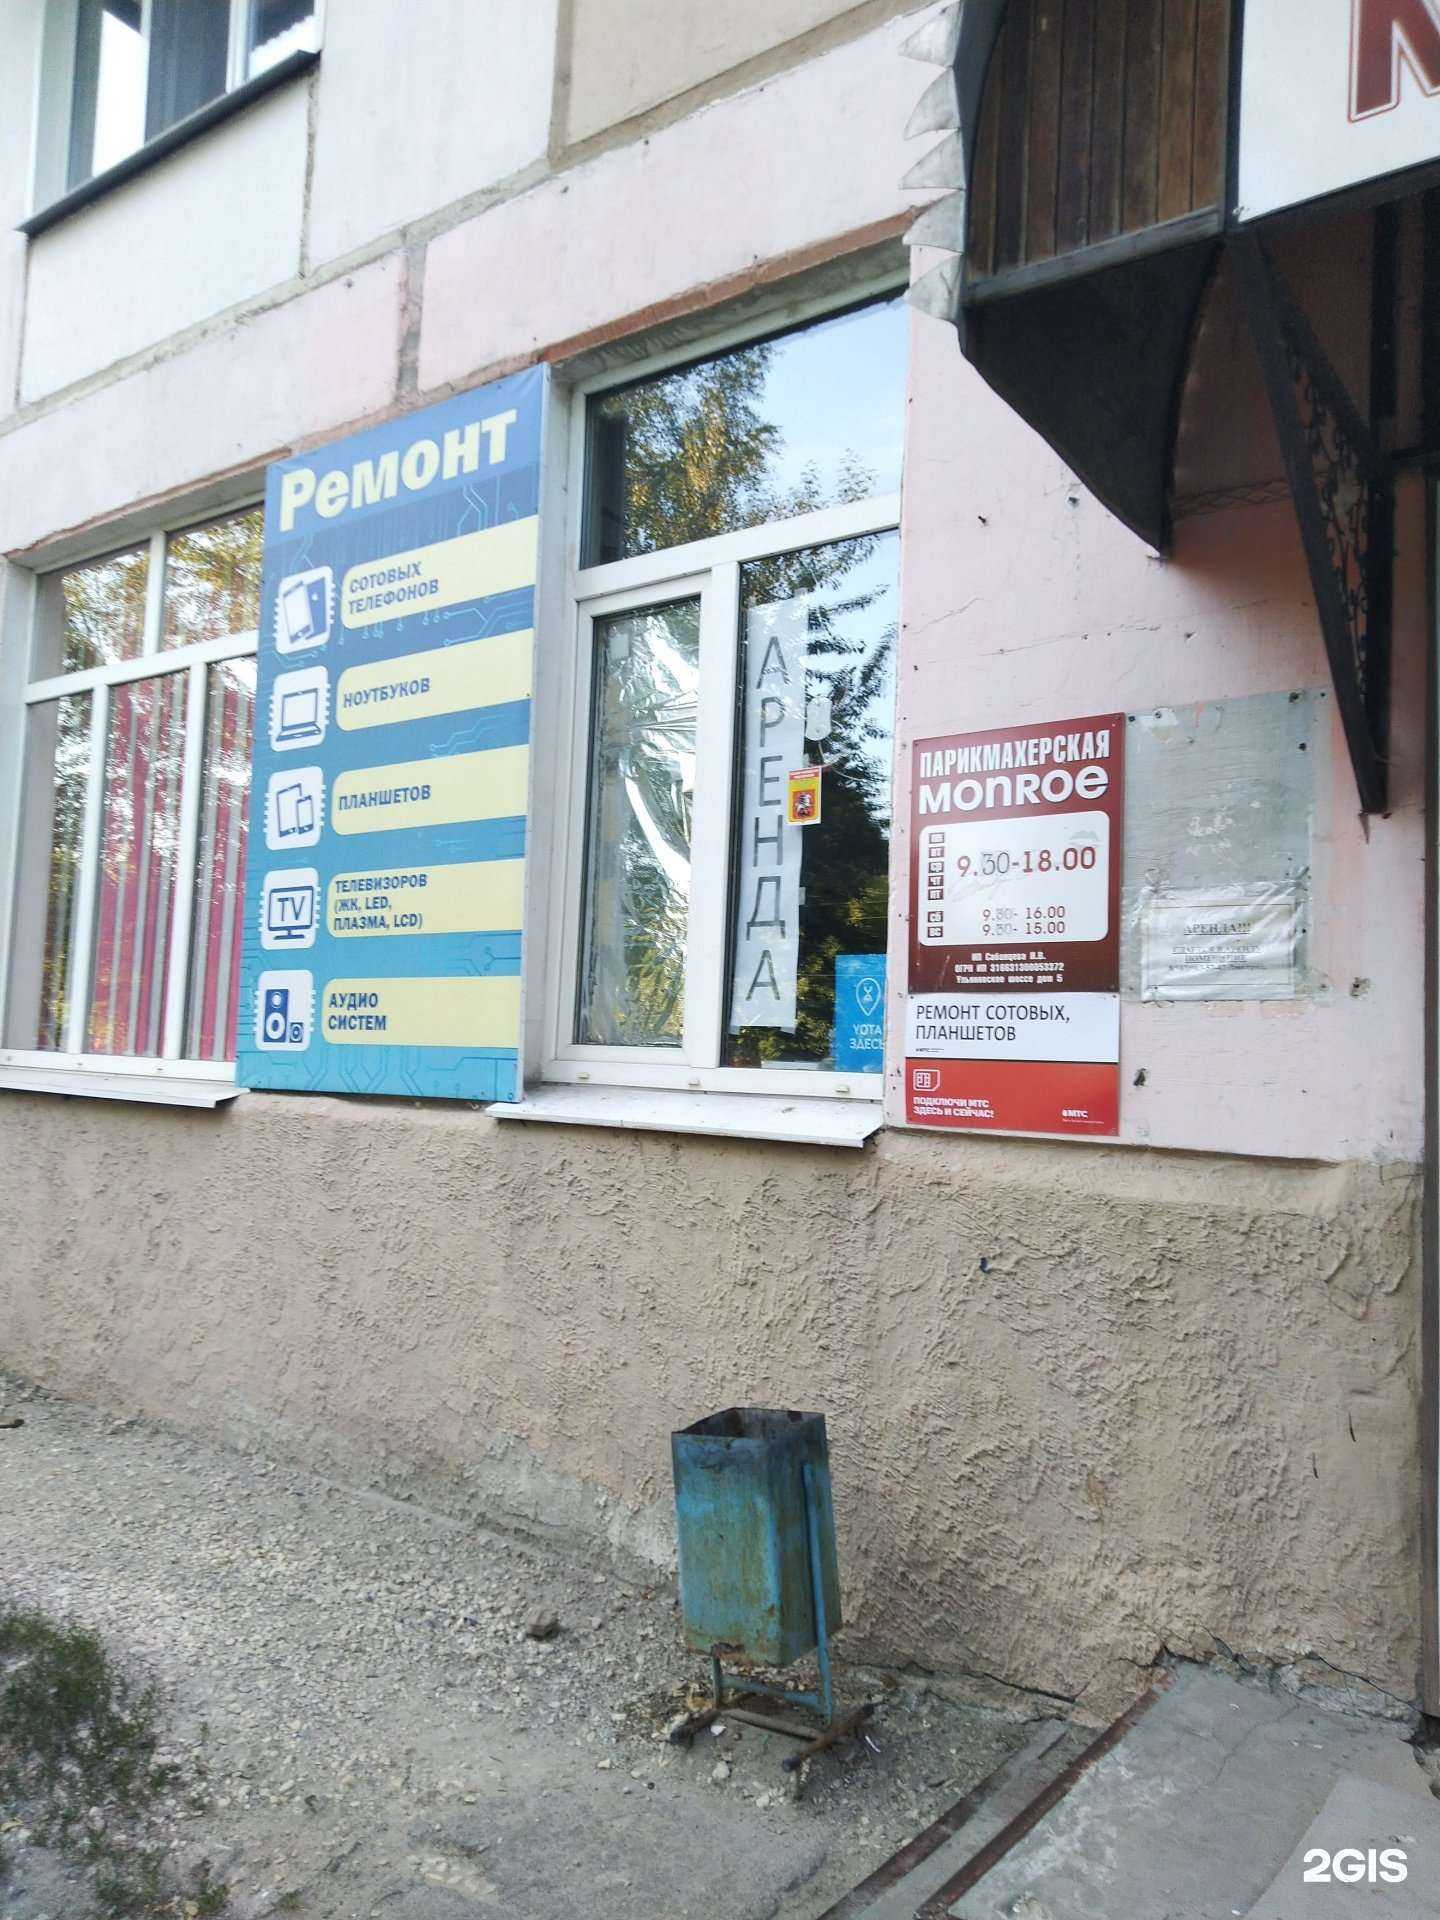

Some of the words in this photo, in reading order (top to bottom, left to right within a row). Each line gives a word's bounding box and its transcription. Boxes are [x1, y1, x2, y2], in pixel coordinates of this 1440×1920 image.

[349, 561, 422, 593] СОТОВЫХ
[348, 579, 439, 615] ТЕЛЕФОНОВ
[343, 677, 431, 708] НОУТБУКОВ
[920, 729, 1110, 778] ПАРИКМАХЕРСКАЯ
[338, 784, 431, 811] ПЛАНШЕТОВ
[746, 635, 790, 1001] АРЕНДА
[335, 874, 428, 893] ТЕЛЕВИЗОРОВ
[277, 896, 306, 921] TV
[334, 898, 362, 914] (ЖК,
[365, 896, 392, 910] LED,
[1025, 906, 1065, 920] 16.00
[333, 915, 390, 931] ПЛАЗМА,
[393, 912, 423, 929] LCD)
[1025, 921, 1065, 935] 15.00
[328, 993, 379, 1011] АУДИО
[328, 1015, 386, 1031] СИСТЕМ
[916, 1004, 981, 1020] РЕМОНТ
[986, 1004, 1071, 1023] СОТОВЫХ,
[915, 1025, 1016, 1041] ПЛАНШЕТОВ
[913, 1106, 943, 1116] ЗДЕСЬ
